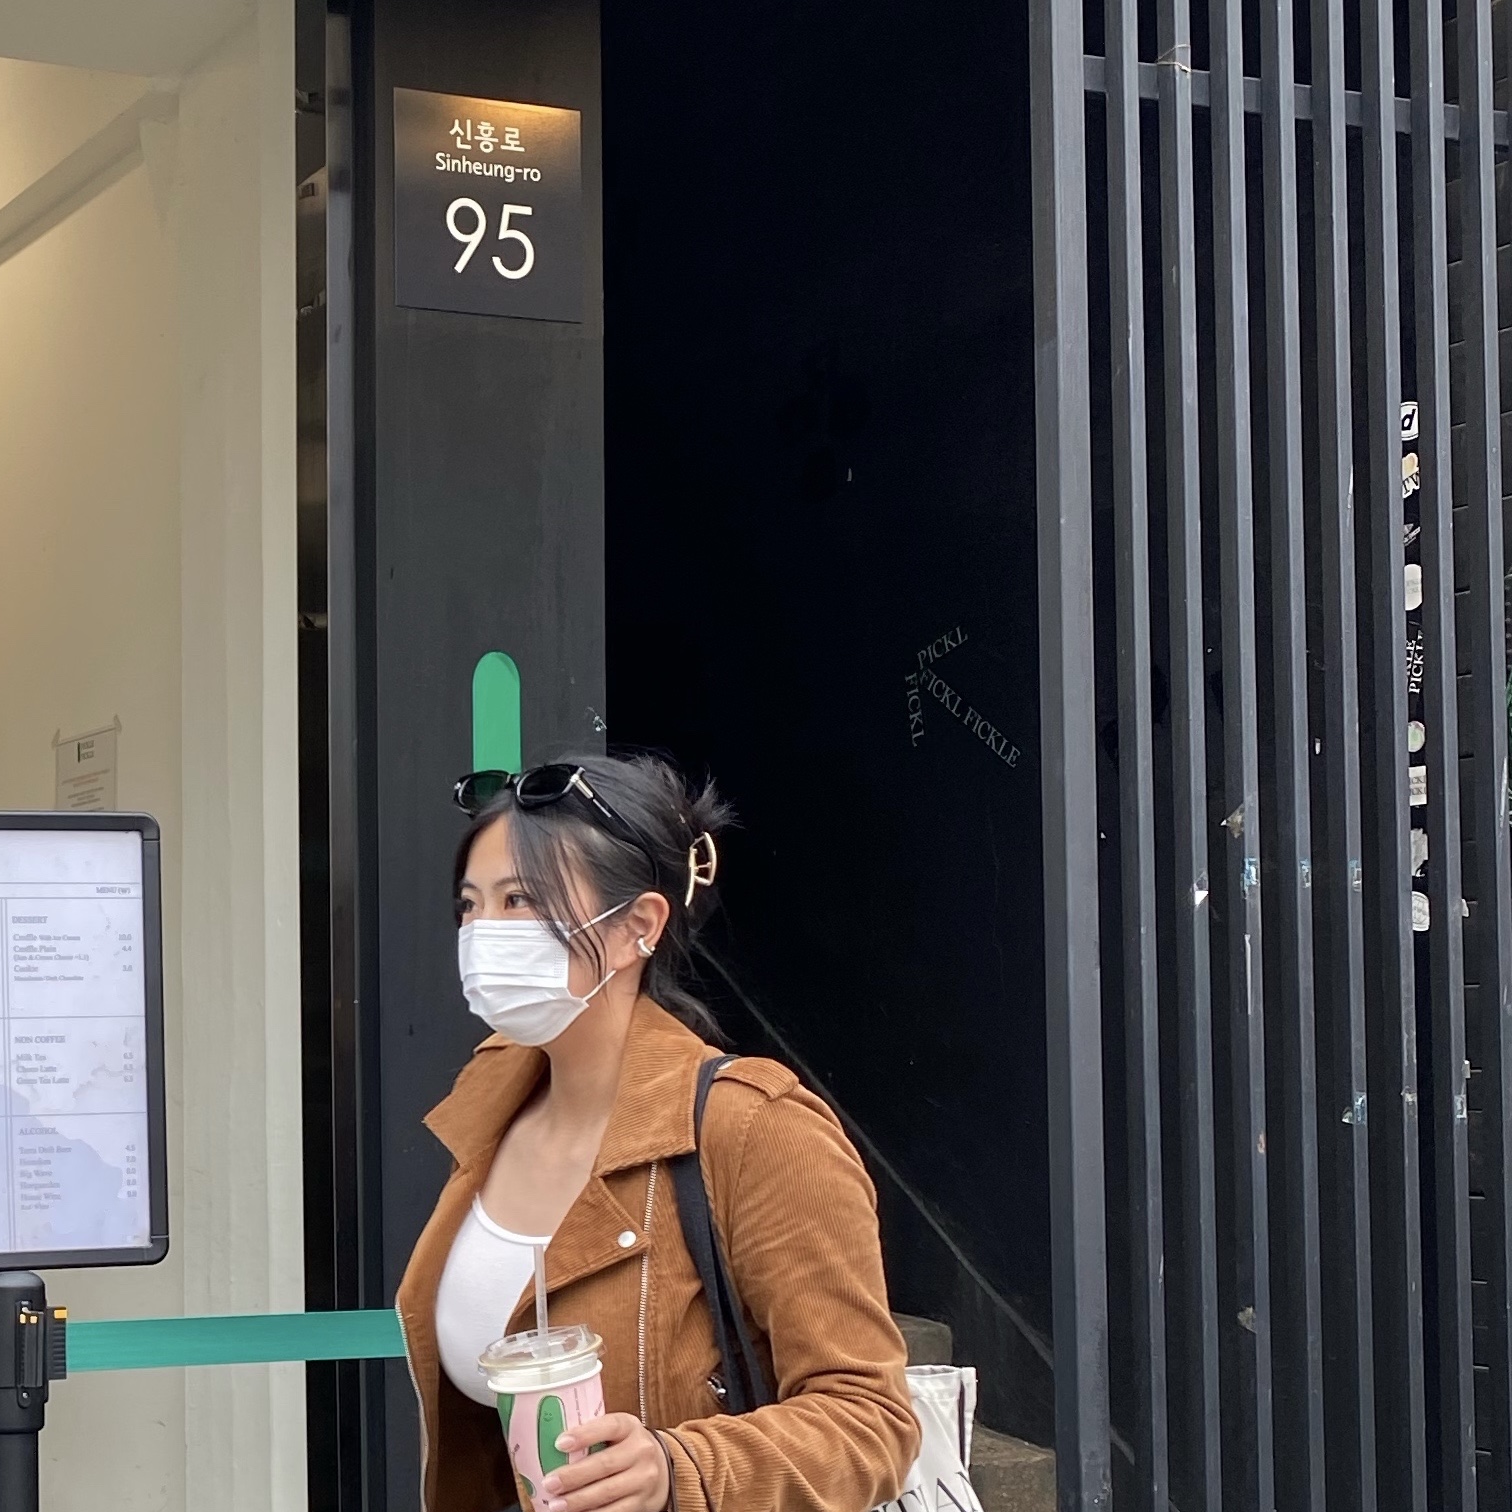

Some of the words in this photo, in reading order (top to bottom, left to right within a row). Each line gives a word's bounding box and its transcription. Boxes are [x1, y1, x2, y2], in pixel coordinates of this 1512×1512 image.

[449, 118, 525, 153] 신흥로
[435, 152, 541, 183] Sinheung-ro
[445, 197, 535, 280] 95
[1409, 629, 1424, 694] PICKL
